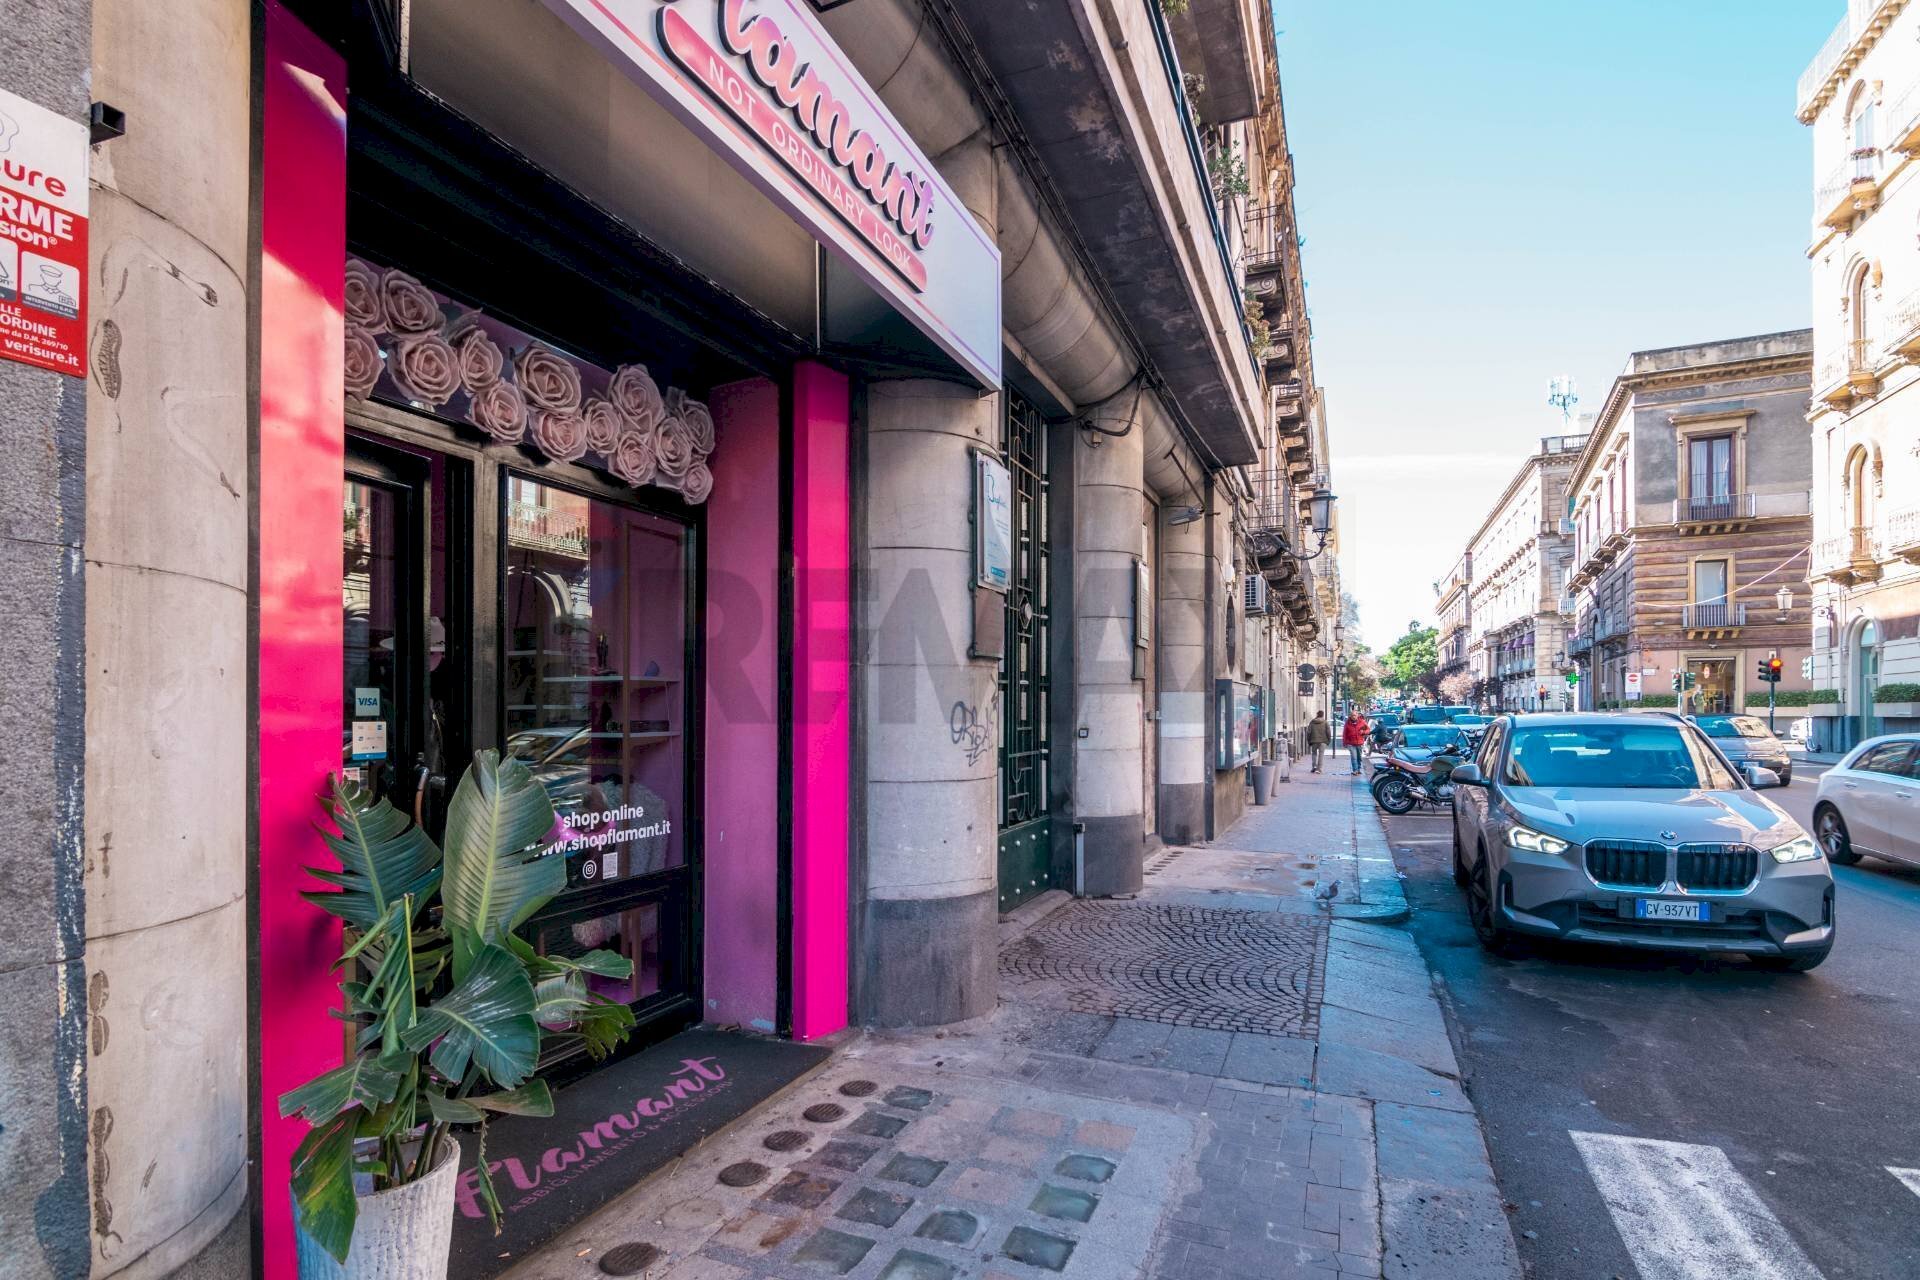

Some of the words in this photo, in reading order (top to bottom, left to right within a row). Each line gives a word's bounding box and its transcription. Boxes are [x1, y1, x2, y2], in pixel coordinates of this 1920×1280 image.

[718, 0, 935, 250] lamant
[0, 158, 66, 198] ure
[709, 55, 757, 119] NOT
[771, 121, 864, 226] ORDINARY
[874, 222, 911, 270] LOOK
[5, 338, 80, 367] verisure.it
[358, 697, 379, 706] VISA
[563, 811, 600, 829] shop
[602, 803, 644, 823] online
[453, 1056, 726, 1219] Flamant
